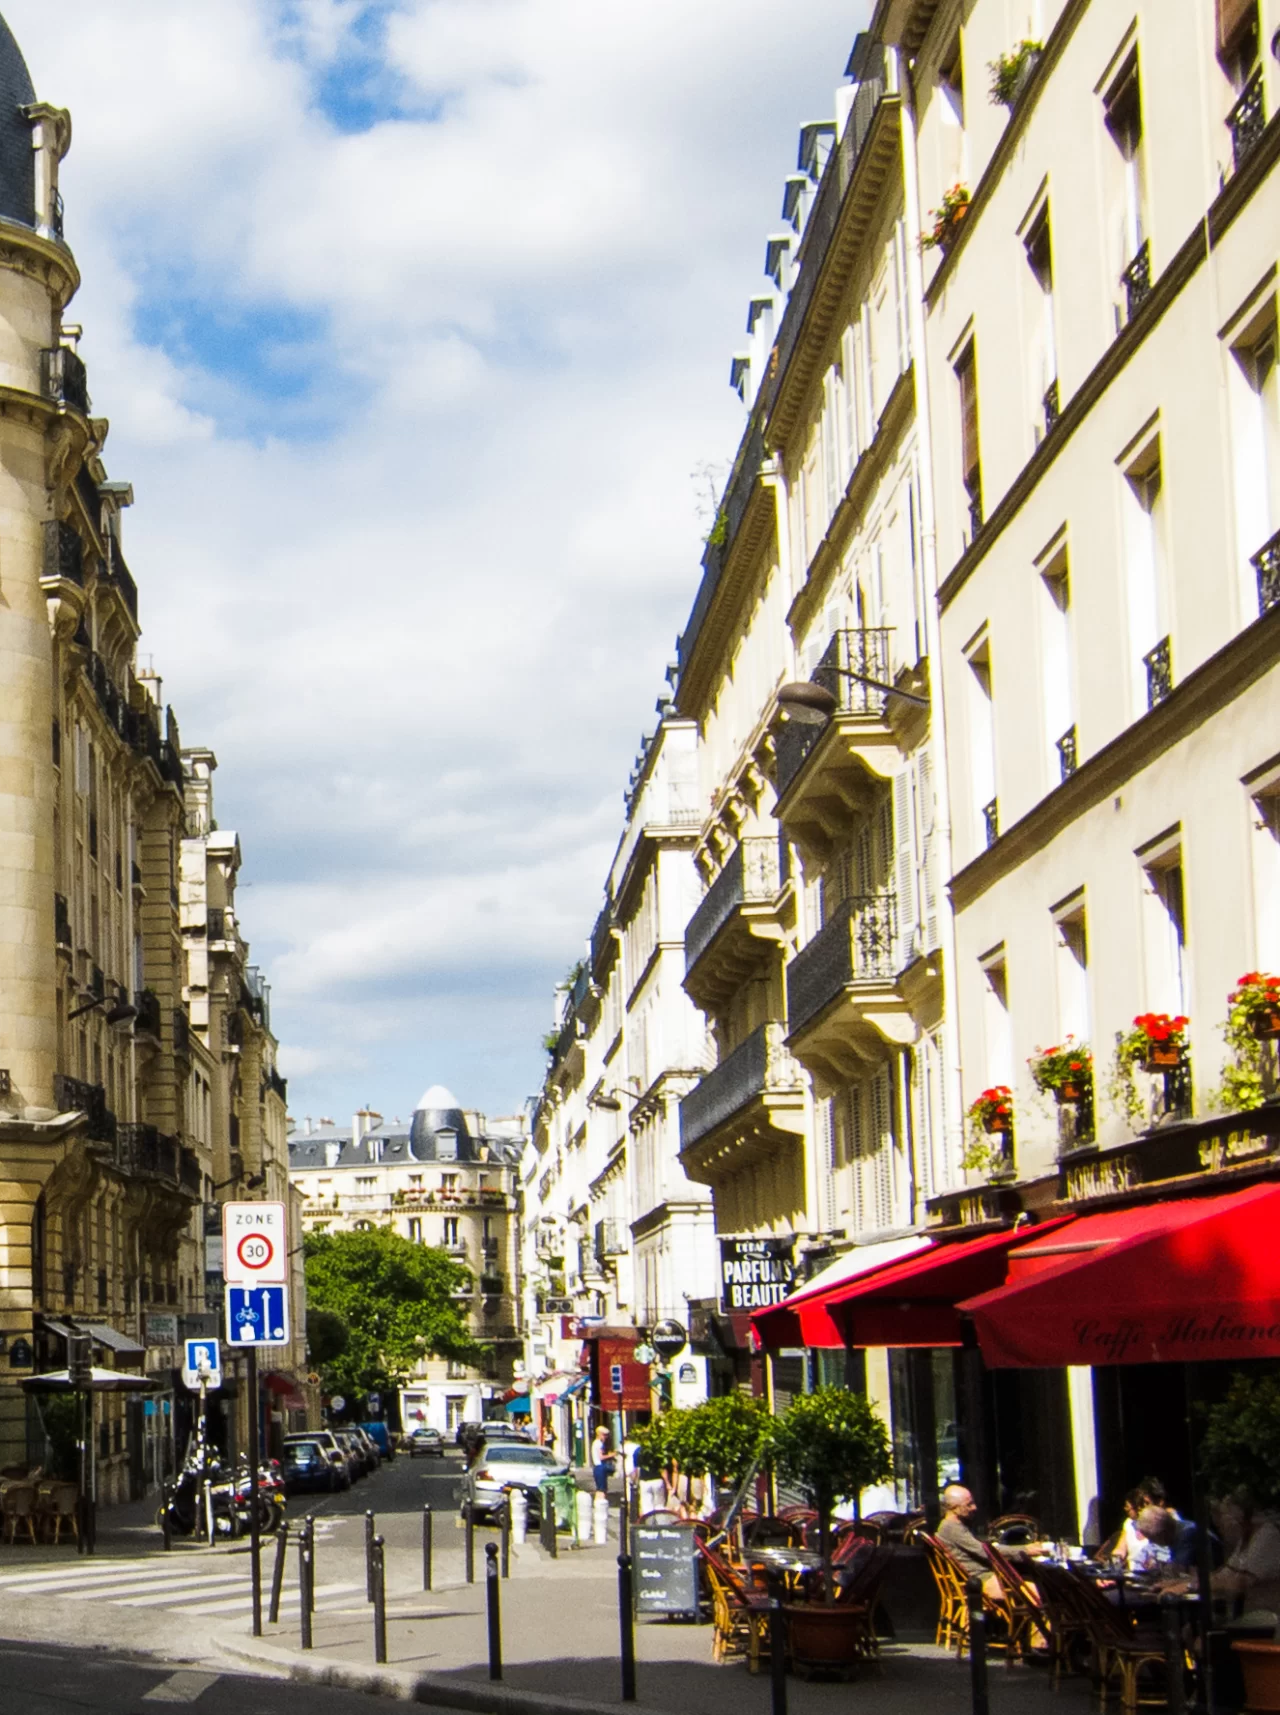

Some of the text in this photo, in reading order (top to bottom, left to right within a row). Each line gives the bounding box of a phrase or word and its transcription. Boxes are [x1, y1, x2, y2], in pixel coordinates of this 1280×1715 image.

[235, 1214, 273, 1225] ZONE
[245, 1244, 265, 1258] 30
[723, 1260, 793, 1284] PARFUMS
